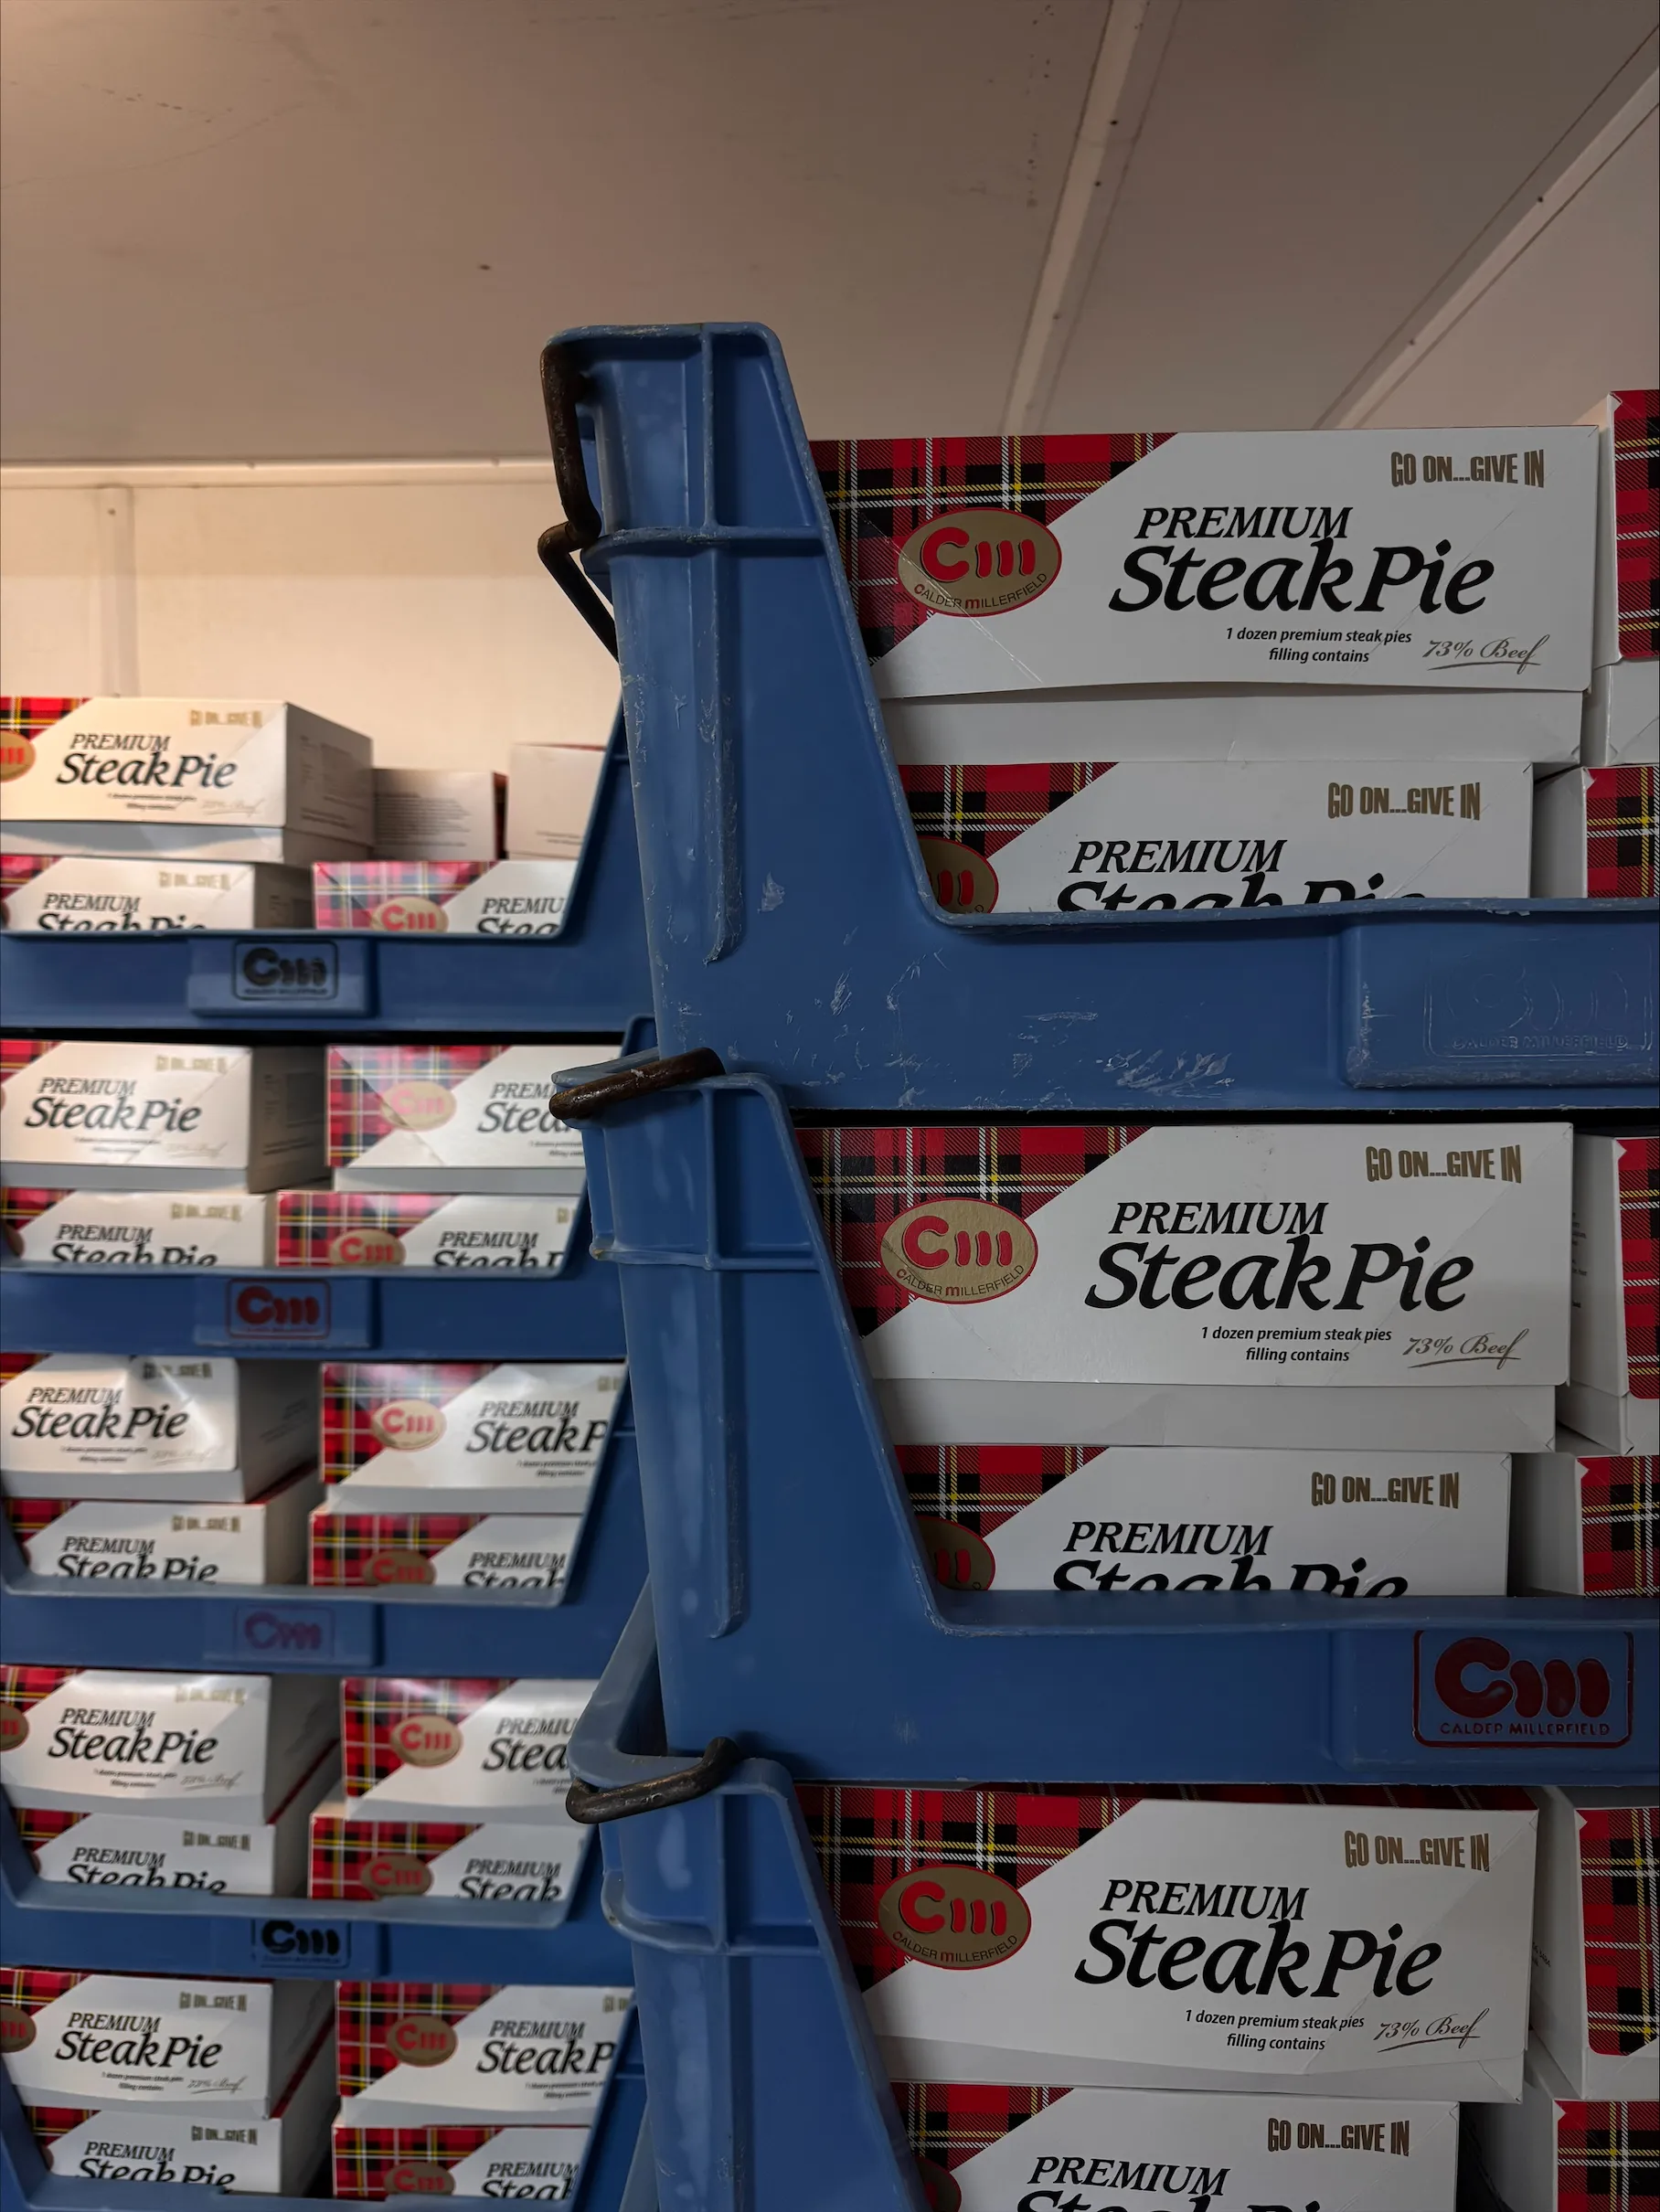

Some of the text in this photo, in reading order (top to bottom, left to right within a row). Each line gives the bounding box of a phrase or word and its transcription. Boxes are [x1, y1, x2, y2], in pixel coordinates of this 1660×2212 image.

[1390, 452, 1417, 487] GO
[1524, 450, 1546, 488] IN
[1133, 506, 1354, 539] PREMIUM
[1108, 537, 1495, 614] Steak Pie
[914, 583, 962, 608] CALDER
[1226, 626, 1412, 646] 1 dozen premium steak pies
[1269, 647, 1369, 665] filling contains
[1422, 634, 1551, 674] 73% Beef
[69, 732, 171, 752] PREMIUM
[56, 751, 239, 788] Steak Pie
[1327, 782, 1354, 820] GO
[1460, 782, 1481, 821] IN
[1068, 839, 1288, 874] PREMIUM
[42, 892, 142, 912] PREMIUM
[483, 898, 566, 914] PREMIU
[37, 1077, 137, 1096] PREMIUM
[490, 1082, 555, 1100] PREMI
[24, 1096, 202, 1133] Steak Pie
[476, 1101, 573, 1133] Stea
[1366, 1144, 1392, 1183] GO
[1500, 1144, 1522, 1184] IN
[56, 1223, 154, 1243] PREMIUM
[1108, 1202, 1329, 1235] PREMIUM
[439, 1230, 539, 1250] PREMIUM
[896, 1268, 942, 1296] CALDER
[1084, 1233, 1474, 1312] Steak Pie
[1201, 1325, 1392, 1345] 1 dozen premium steak pies
[1402, 1328, 1529, 1370] 73% Beef
[1245, 1346, 1349, 1363] filling contains
[25, 1387, 123, 1405] PREMIUM
[479, 1400, 580, 1418] PREMIUM
[11, 1402, 189, 1440] Steak Pie
[466, 1417, 577, 1453] Steak
[1311, 1472, 1335, 1506] GO
[1439, 1471, 1460, 1510] IN
[61, 1536, 155, 1555] PREMIUM
[1062, 1521, 1273, 1557] PREMIUM
[467, 1552, 566, 1569] PREMIUM
[59, 1707, 155, 1728] PREMIUM
[495, 1717, 578, 1737] PREMIU
[1509, 1722, 1611, 1736] MILLERFIELD
[48, 1726, 218, 1764] Steak Pie
[481, 1738, 569, 1771] Stea
[71, 1846, 167, 1867] PREMIUM
[1344, 1830, 1369, 1868] GO
[1470, 1833, 1491, 1872] IN
[464, 1858, 561, 1877] PREMIUM
[1100, 1878, 1310, 1921] PREMIUM
[892, 1930, 938, 1961] CALDER
[1074, 1918, 1442, 1998] Steak Pie
[67, 2013, 162, 2033] PREMIUM
[488, 2020, 586, 2038] PREMIUM
[1185, 2009, 1365, 2031] 1 dozen premium steak pies
[1373, 2007, 1490, 2047] 73% Beef
[54, 2030, 223, 2068] Steak Pie
[1227, 2033, 1325, 2050] filling contains
[475, 2039, 586, 2075] Steak
[83, 2141, 176, 2162] PREMIUM
[1267, 2117, 1291, 2153] GO
[1390, 2119, 1410, 2157] IN
[486, 2162, 580, 2179] PREMIUM
[1027, 2155, 1231, 2196] PREMIUM
